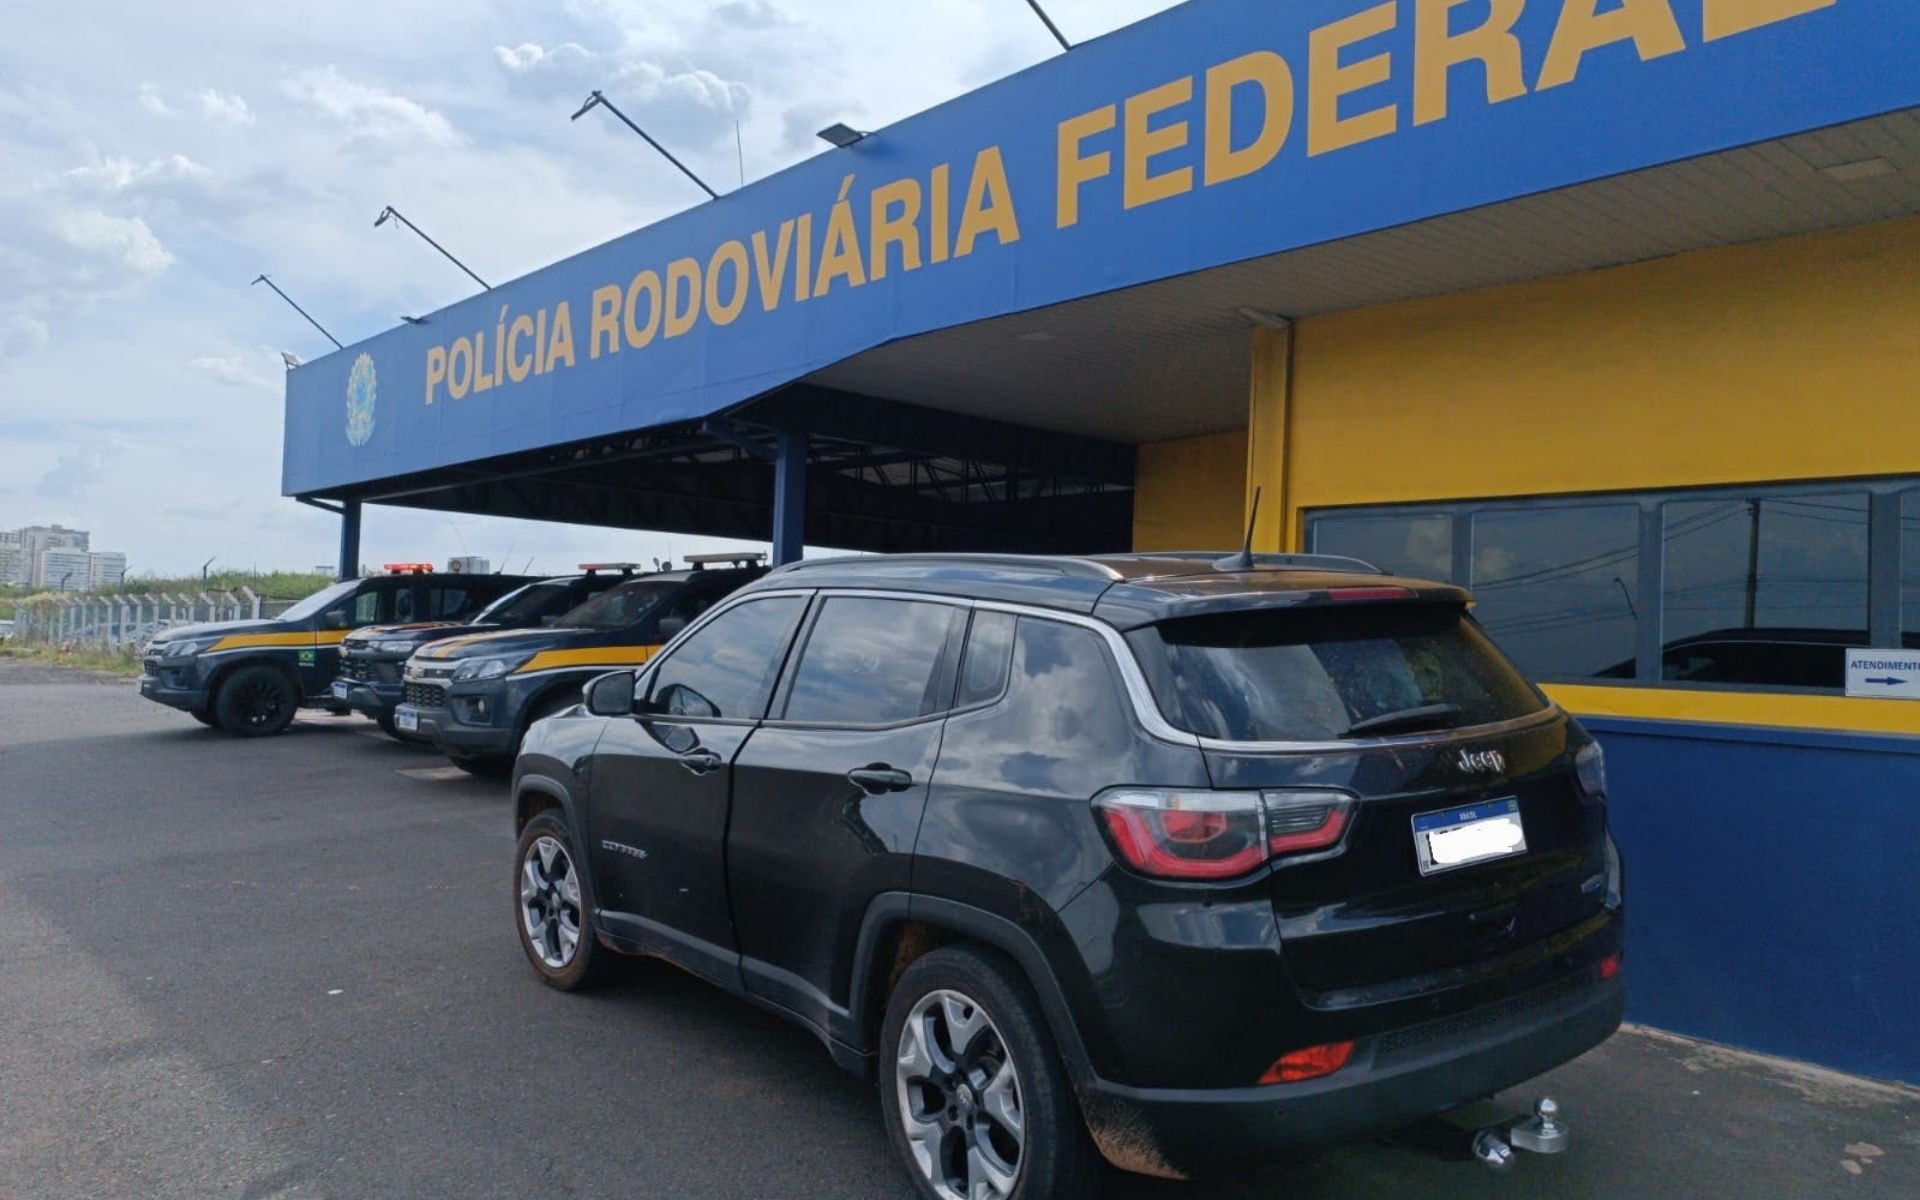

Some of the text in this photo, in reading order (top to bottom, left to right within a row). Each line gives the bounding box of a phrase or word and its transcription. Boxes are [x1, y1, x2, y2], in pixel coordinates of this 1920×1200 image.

[425, 0, 1837, 405] POLÍCIA RODOVIÁRIA FEDERA
[1458, 748, 1506, 773] Jeep
